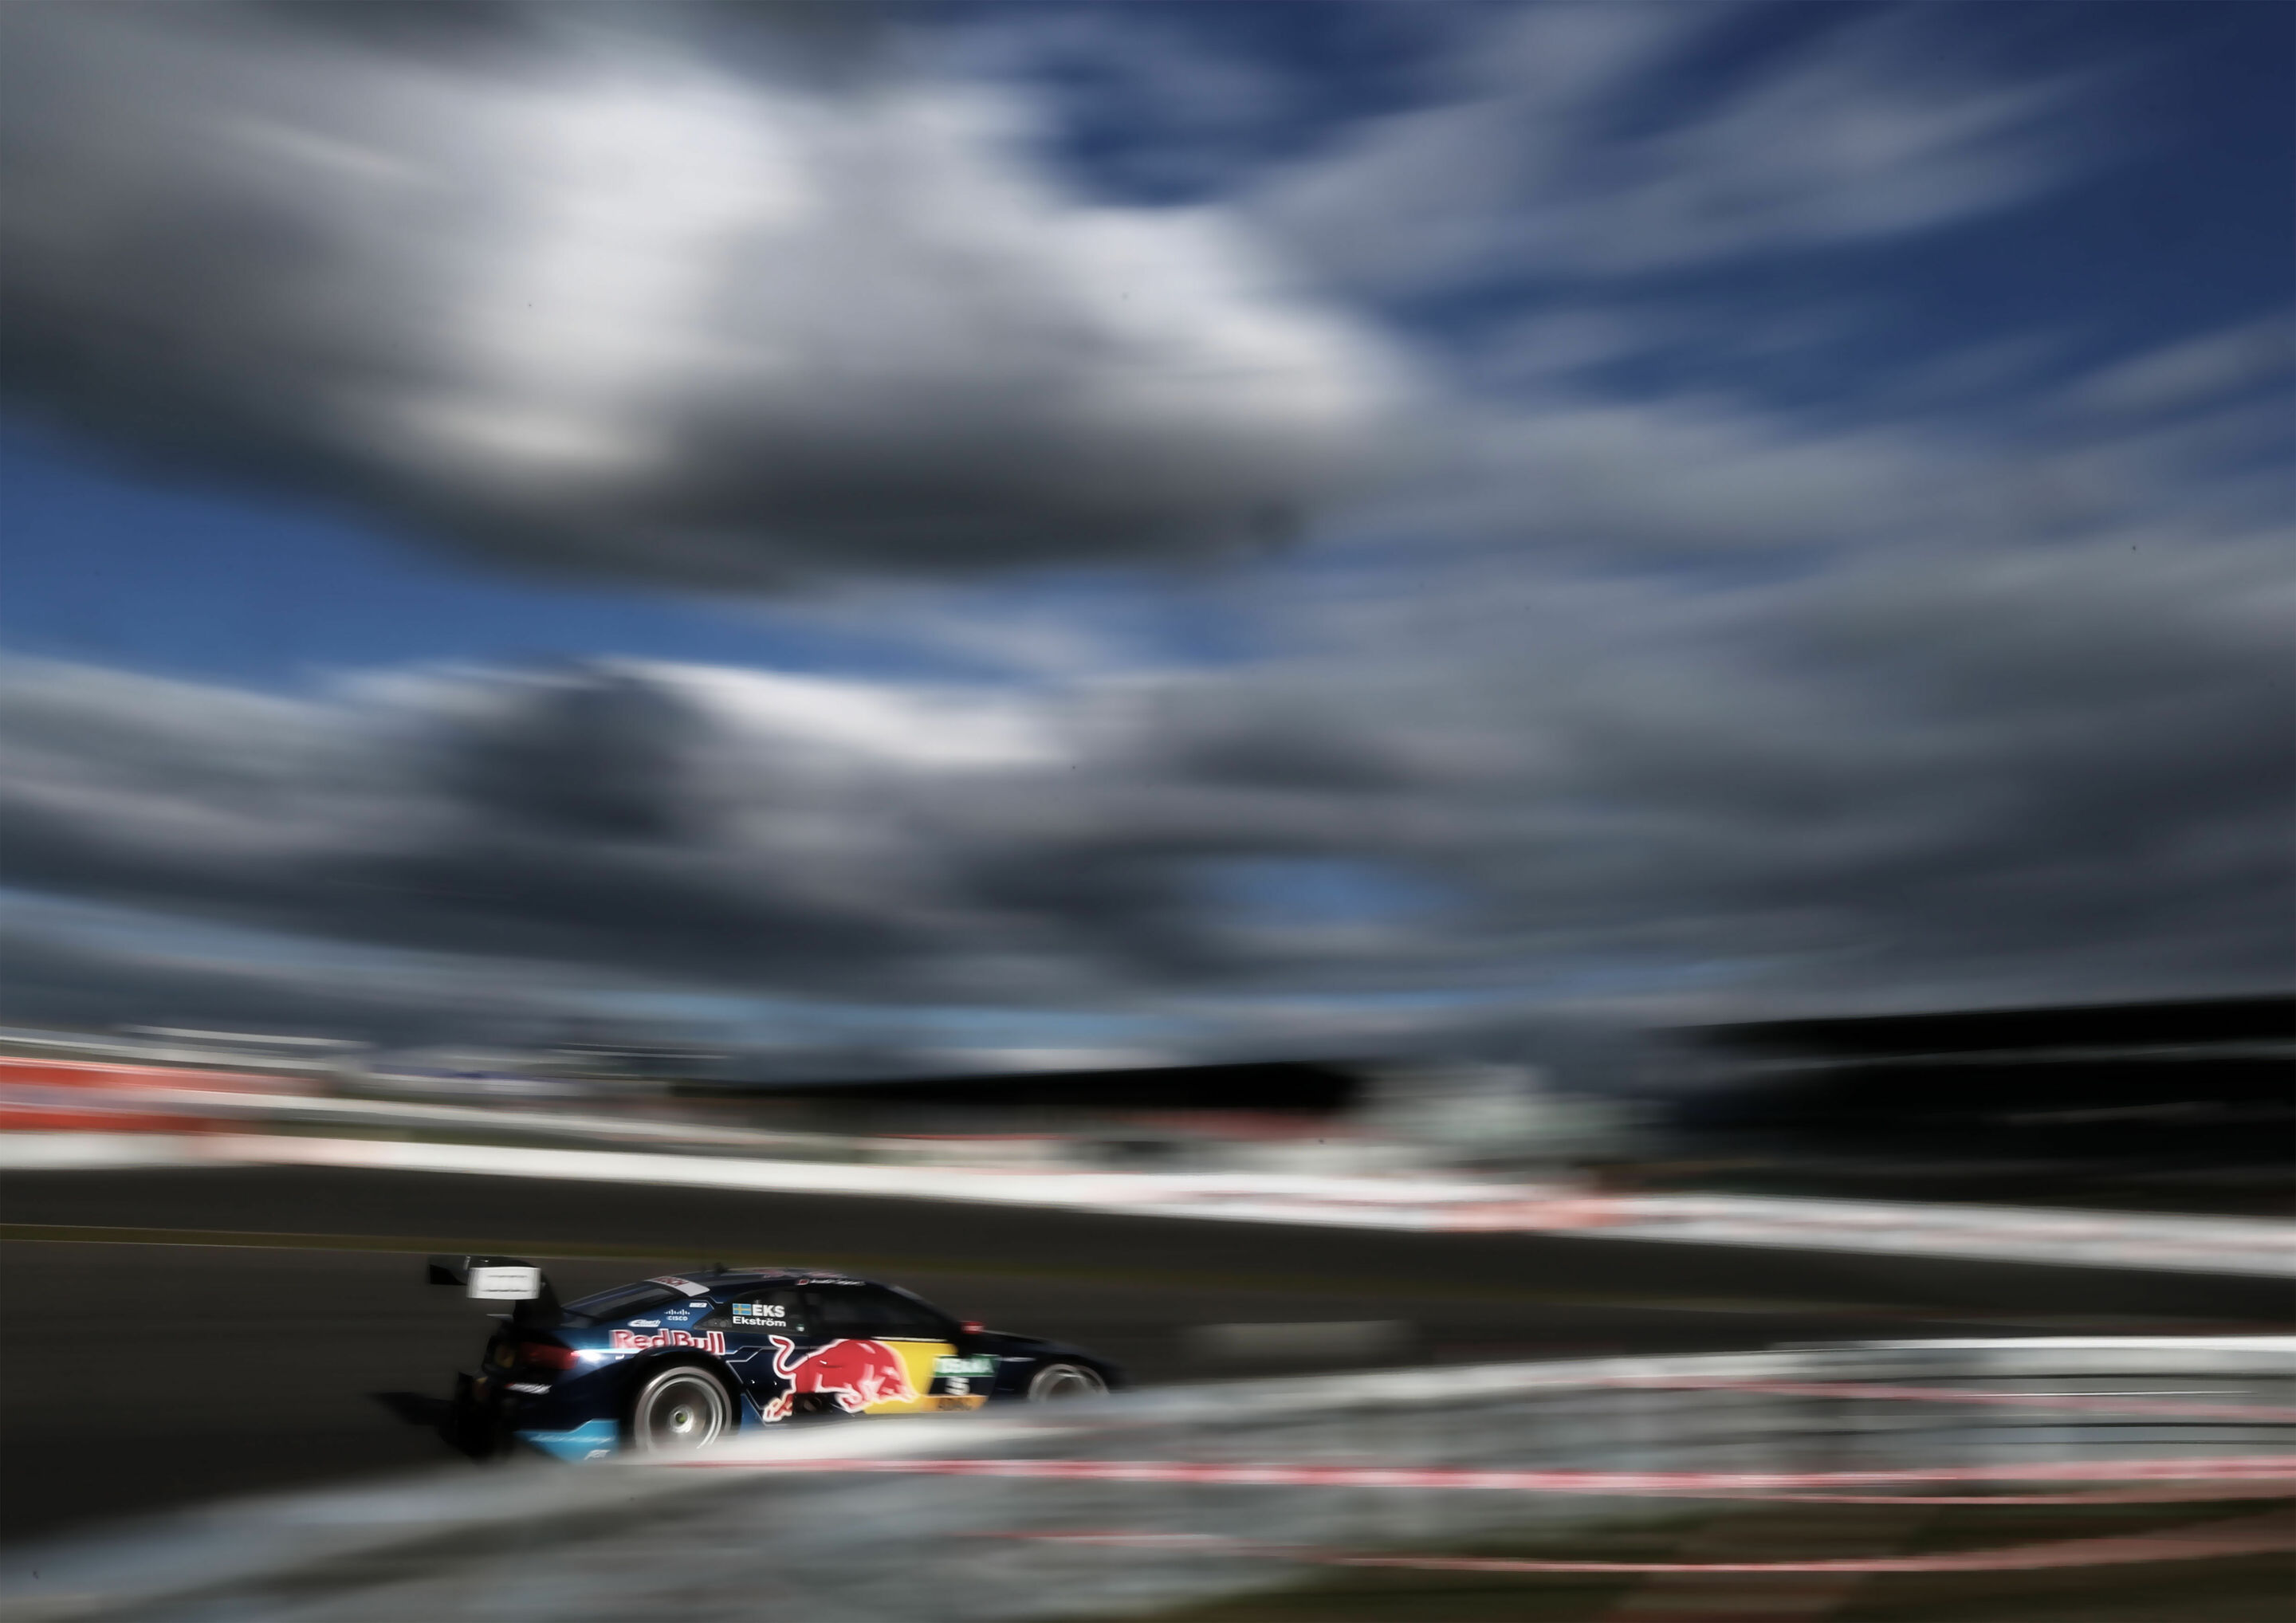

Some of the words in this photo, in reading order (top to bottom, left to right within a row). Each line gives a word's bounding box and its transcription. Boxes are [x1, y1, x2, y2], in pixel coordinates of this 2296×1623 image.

[752, 1304, 785, 1318] EKS
[733, 1316, 787, 1327] Ekström
[609, 1329, 670, 1350] Red
[670, 1330, 725, 1355] Bull
